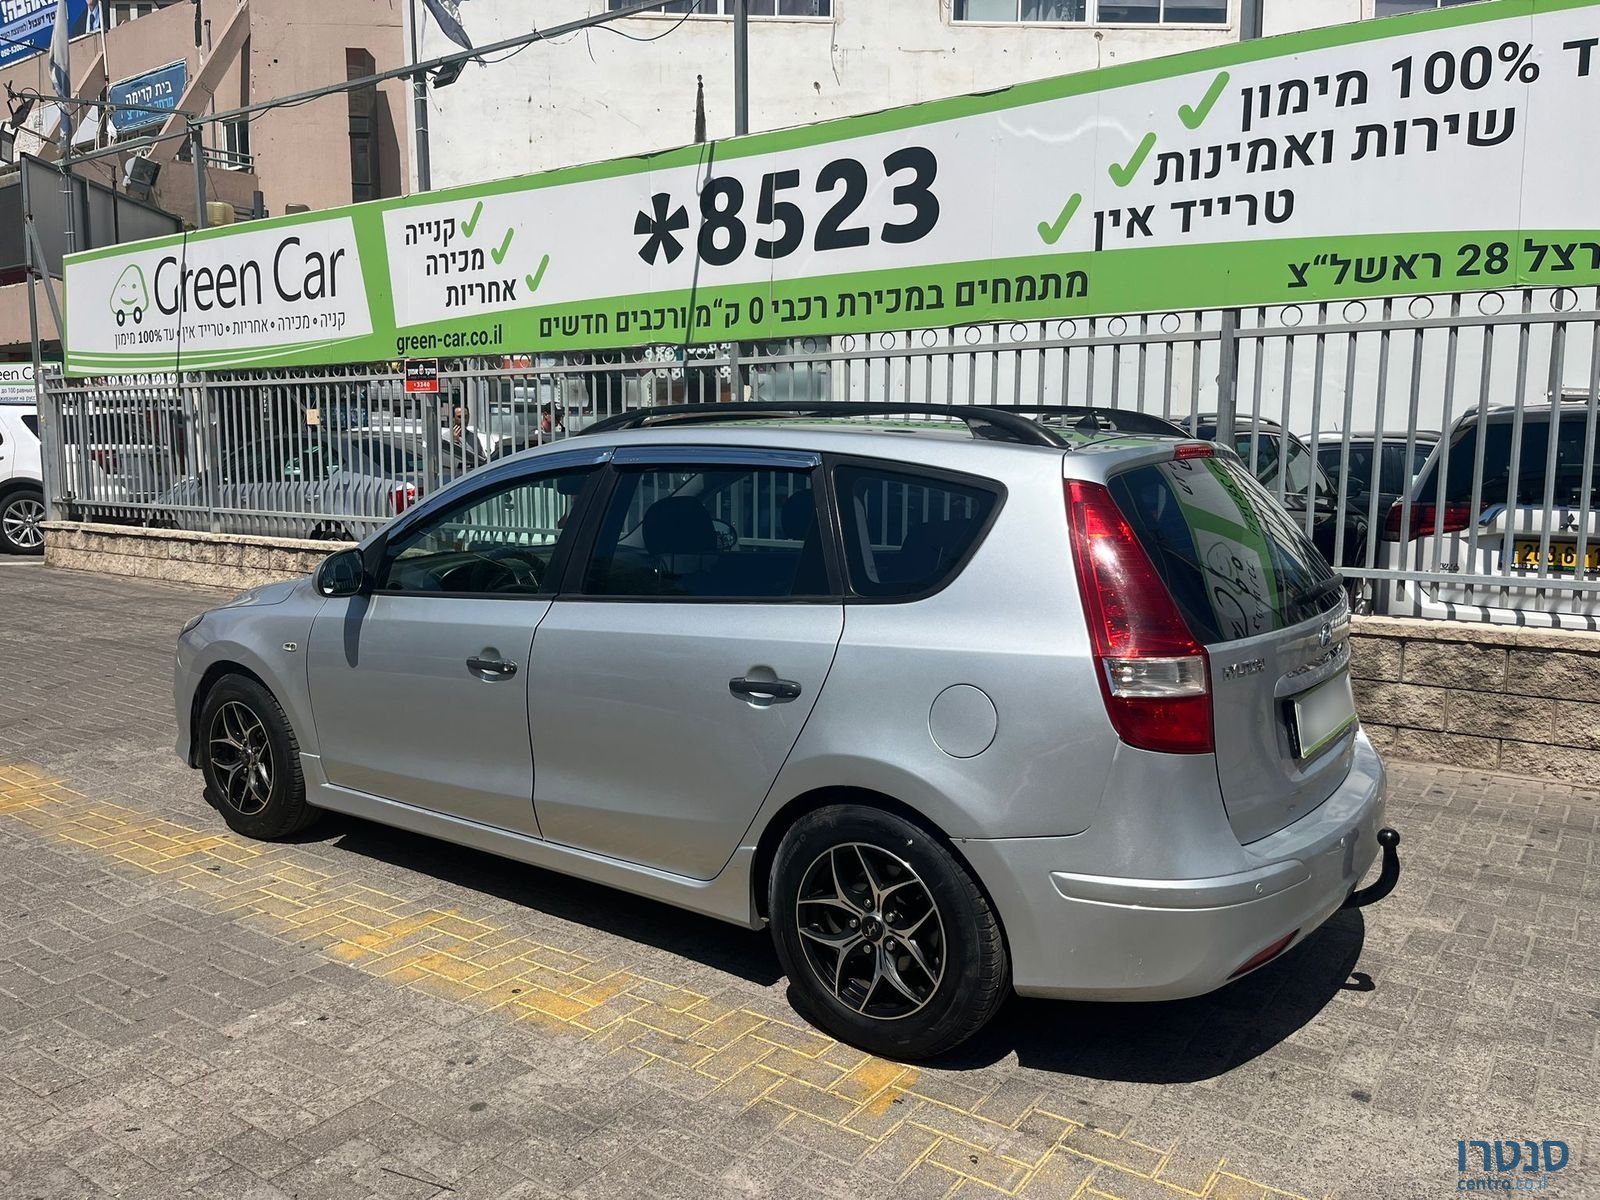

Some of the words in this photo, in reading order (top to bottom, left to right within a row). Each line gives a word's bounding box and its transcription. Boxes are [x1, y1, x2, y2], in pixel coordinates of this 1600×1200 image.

[1391, 41, 1540, 99] 100%
[125, 86, 153, 105] קדימה
[155, 81, 173, 97] בית
[1241, 70, 1369, 132] מימון
[1351, 107, 1516, 161] שירות
[1153, 130, 1334, 186] ואמינות
[1170, 189, 1295, 233] טרייד
[405, 218, 455, 247] קנייה
[1094, 205, 1155, 251] אין
[426, 248, 484, 276] מכירה
[1287, 252, 1442, 288] ראשל"צ
[1456, 242, 1509, 276] 28
[154, 256, 262, 315] Green
[273, 236, 345, 302] Car
[955, 270, 1089, 307] מתמחים
[446, 279, 517, 307] אחריות
[836, 284, 944, 317] במכירת
[278, 315, 310, 331] מכירה
[320, 312, 345, 331] קניה
[616, 306, 687, 333] ורכבים
[696, 298, 740, 328] ק"מ
[749, 296, 764, 324] 0
[772, 295, 828, 323] רכבי
[138, 329, 162, 344] 100%
[163, 328, 175, 341] עד
[182, 325, 196, 343] אין
[198, 323, 224, 338] טרייד
[233, 319, 268, 335] אחריות
[396, 325, 503, 355] green-car.co.il
[539, 314, 608, 338] חדשים
[114, 332, 136, 350] מימון
